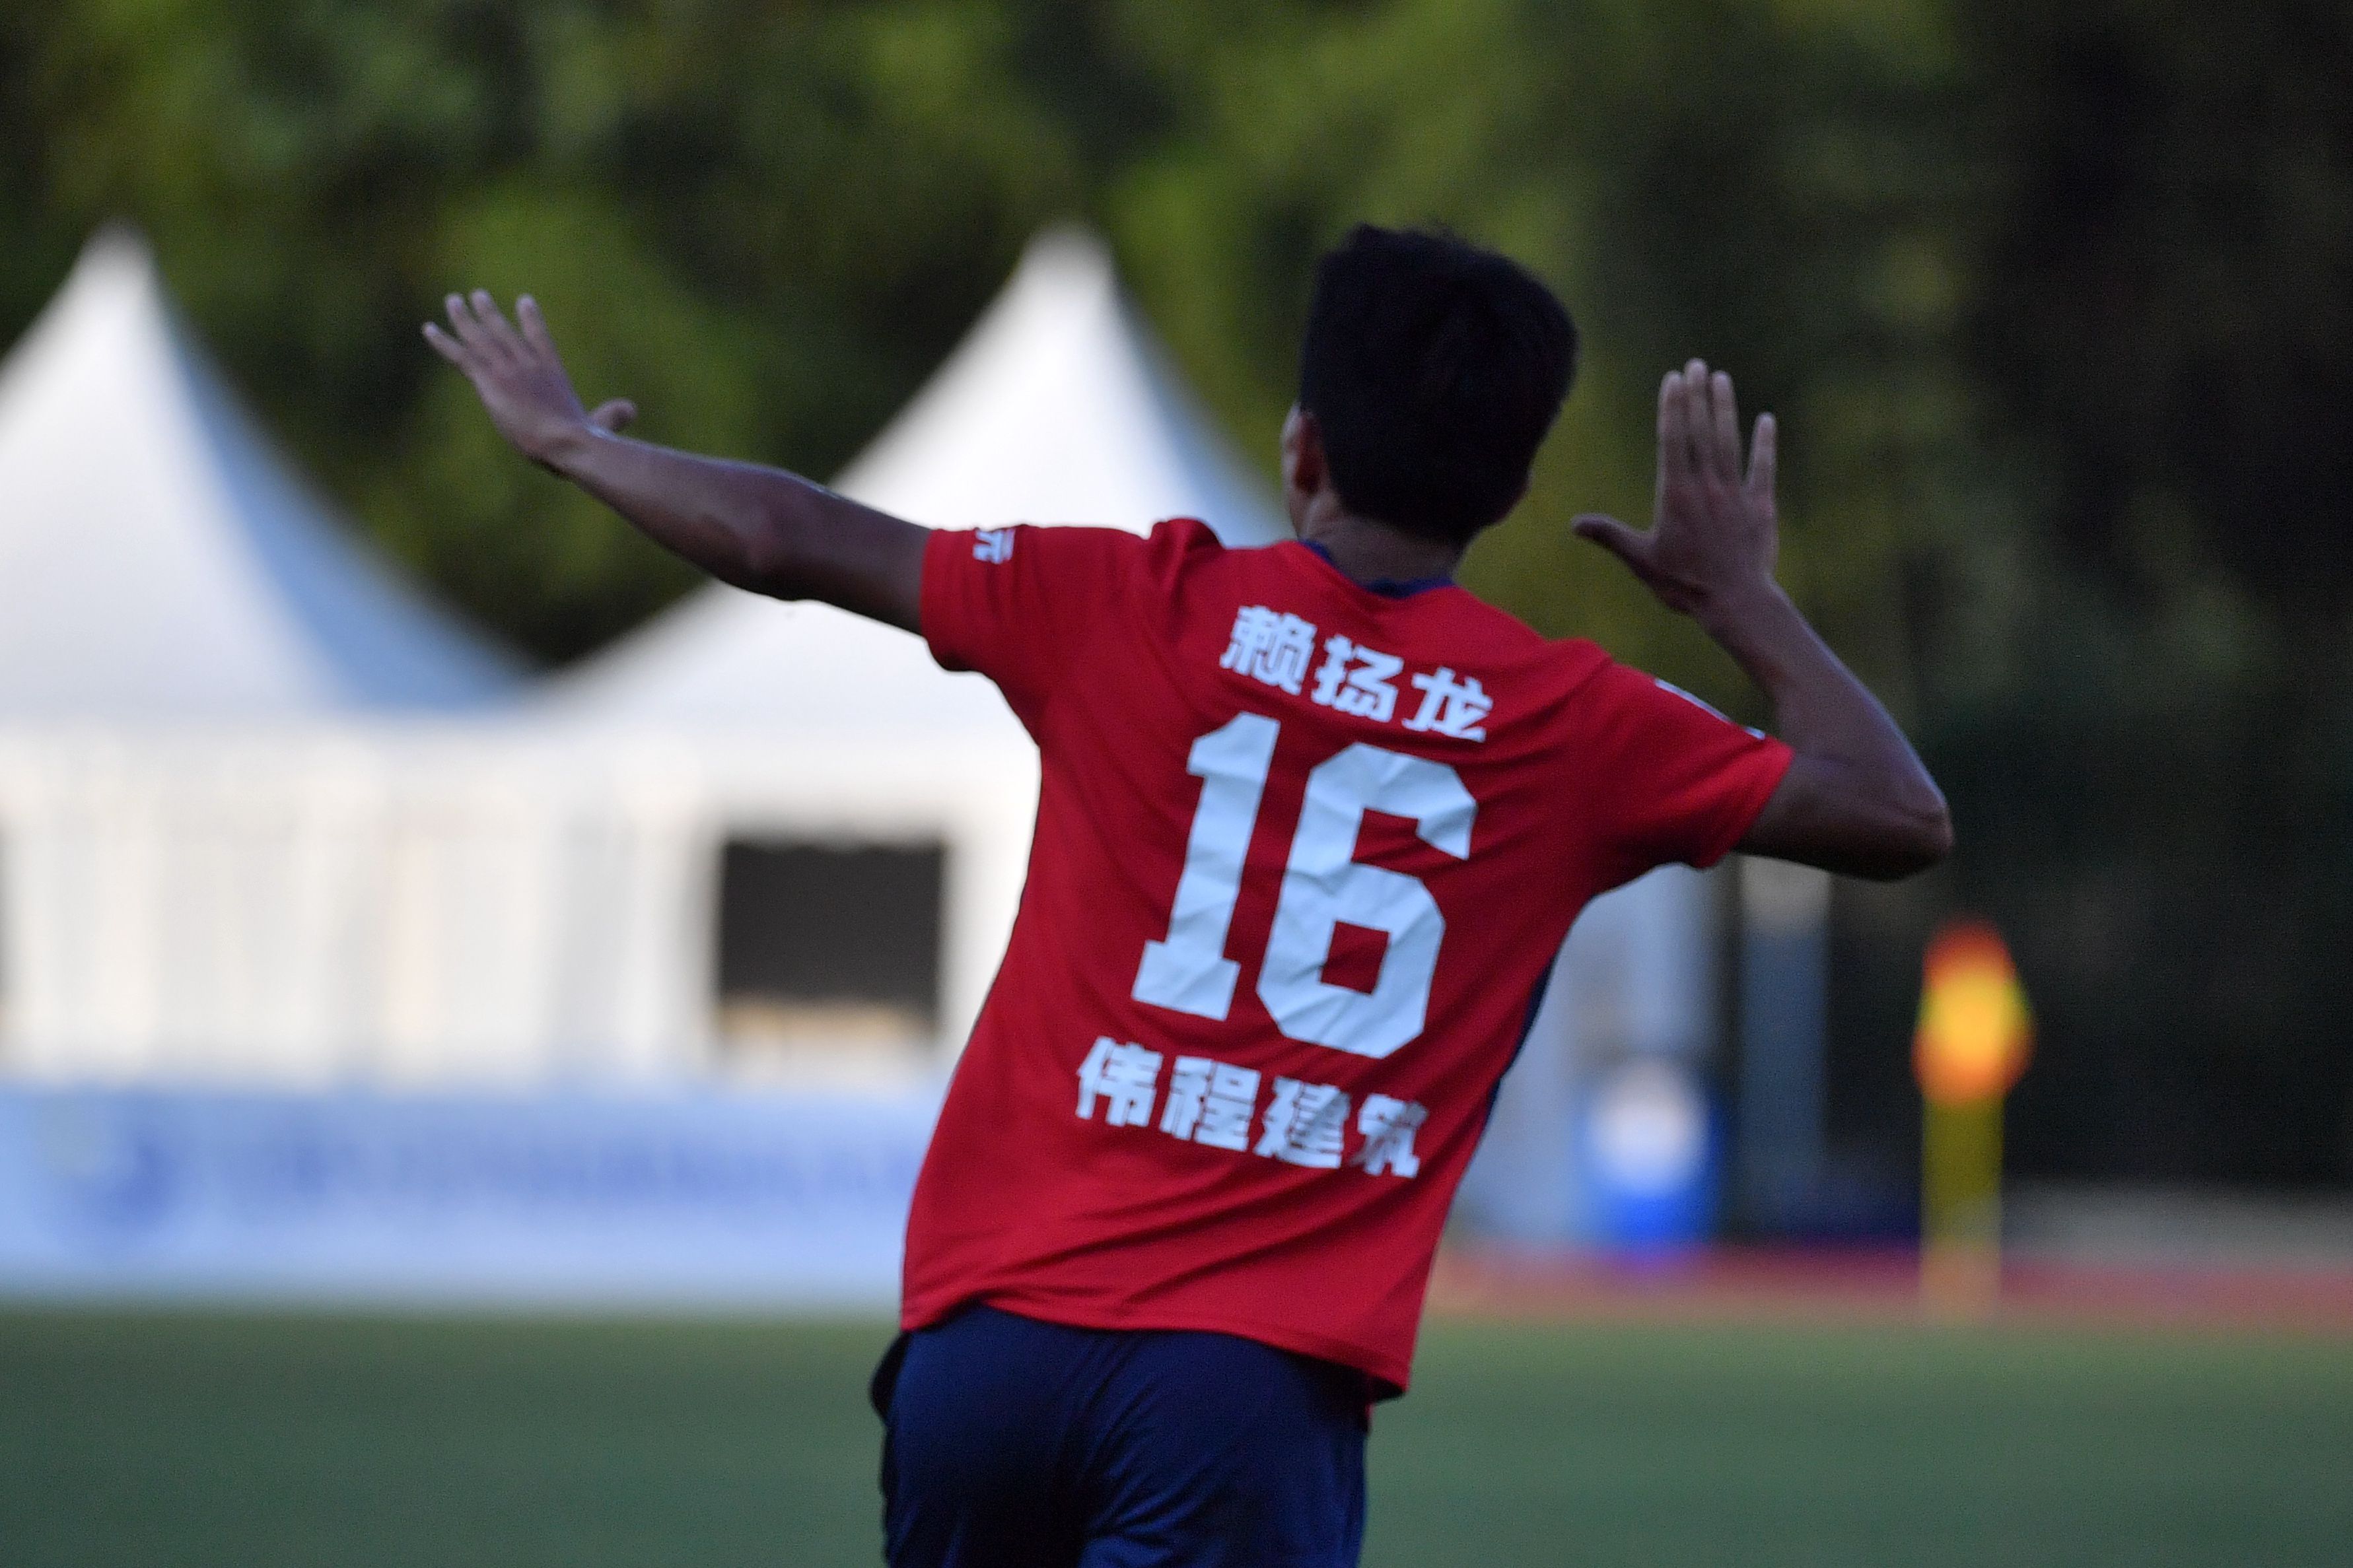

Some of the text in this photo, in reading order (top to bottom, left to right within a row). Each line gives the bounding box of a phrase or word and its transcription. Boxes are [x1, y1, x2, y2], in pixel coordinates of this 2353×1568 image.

[1220, 605, 1493, 742] 赖扬龙
[1131, 712, 1477, 1060] 16
[1075, 1036, 1428, 1178] 伟程建筑
